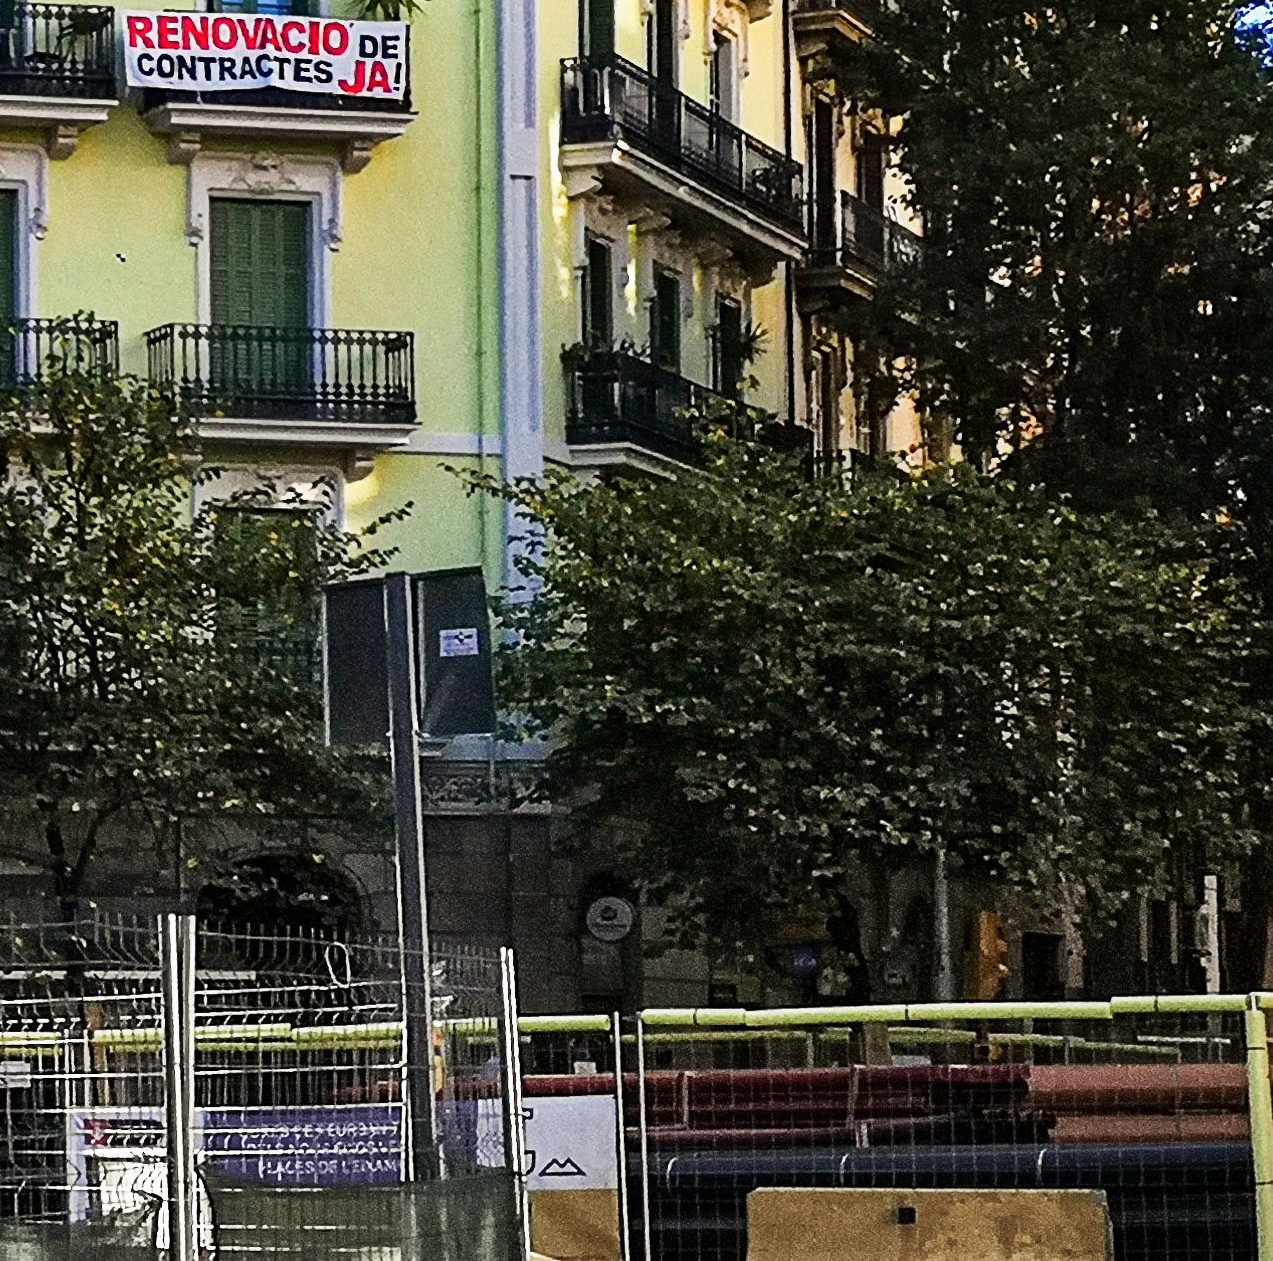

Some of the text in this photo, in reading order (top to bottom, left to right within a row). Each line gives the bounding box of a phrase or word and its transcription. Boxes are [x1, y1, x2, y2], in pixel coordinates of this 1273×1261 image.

[359, 34, 400, 59] DE
[137, 53, 402, 94] CONTRACTES JA!
